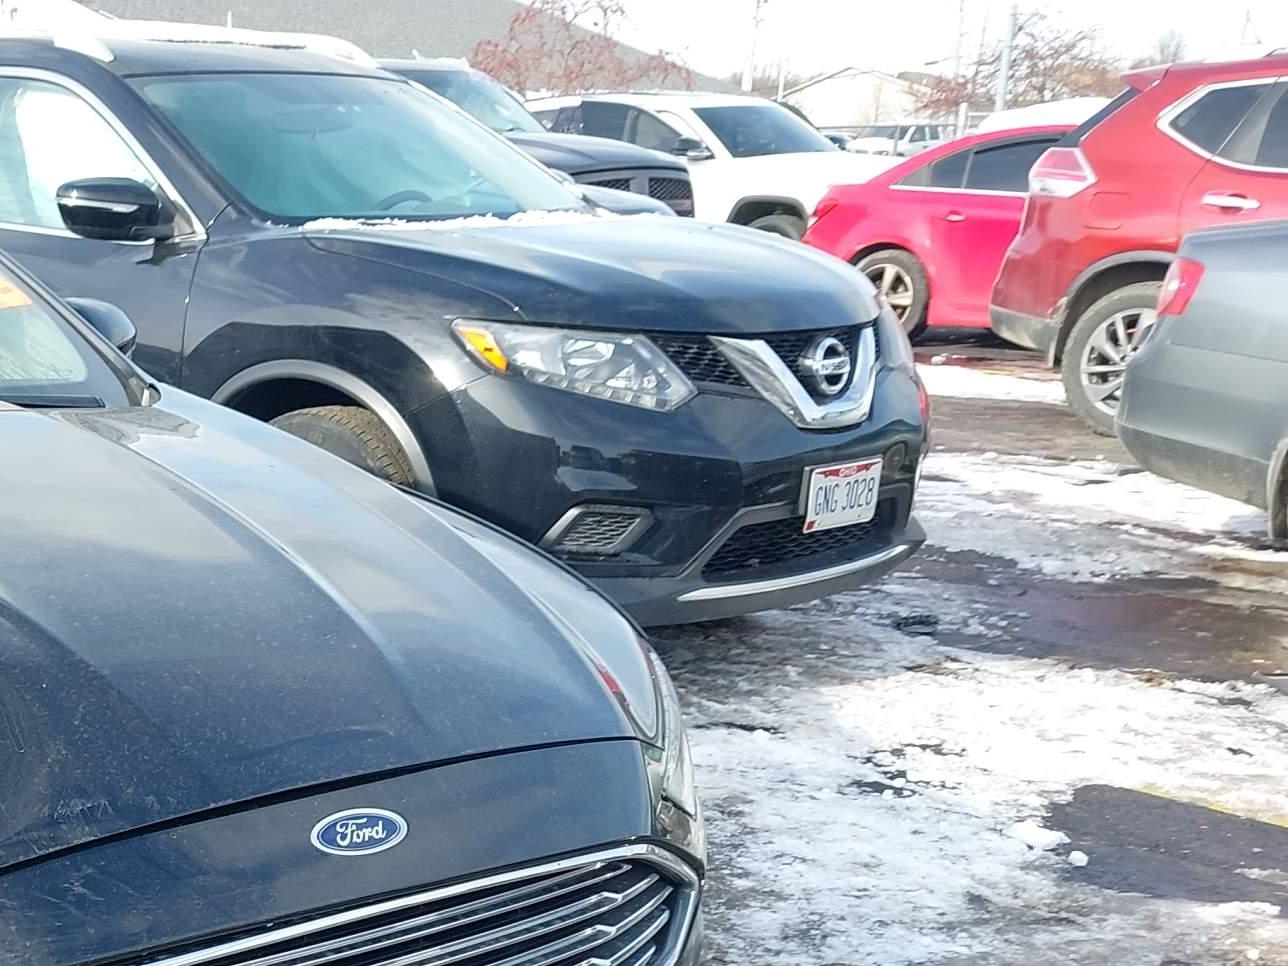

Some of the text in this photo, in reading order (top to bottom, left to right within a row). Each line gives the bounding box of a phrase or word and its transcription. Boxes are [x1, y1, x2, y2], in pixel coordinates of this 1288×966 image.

[815, 476, 875, 516] GNG 3028
[335, 817, 387, 847] Ford
